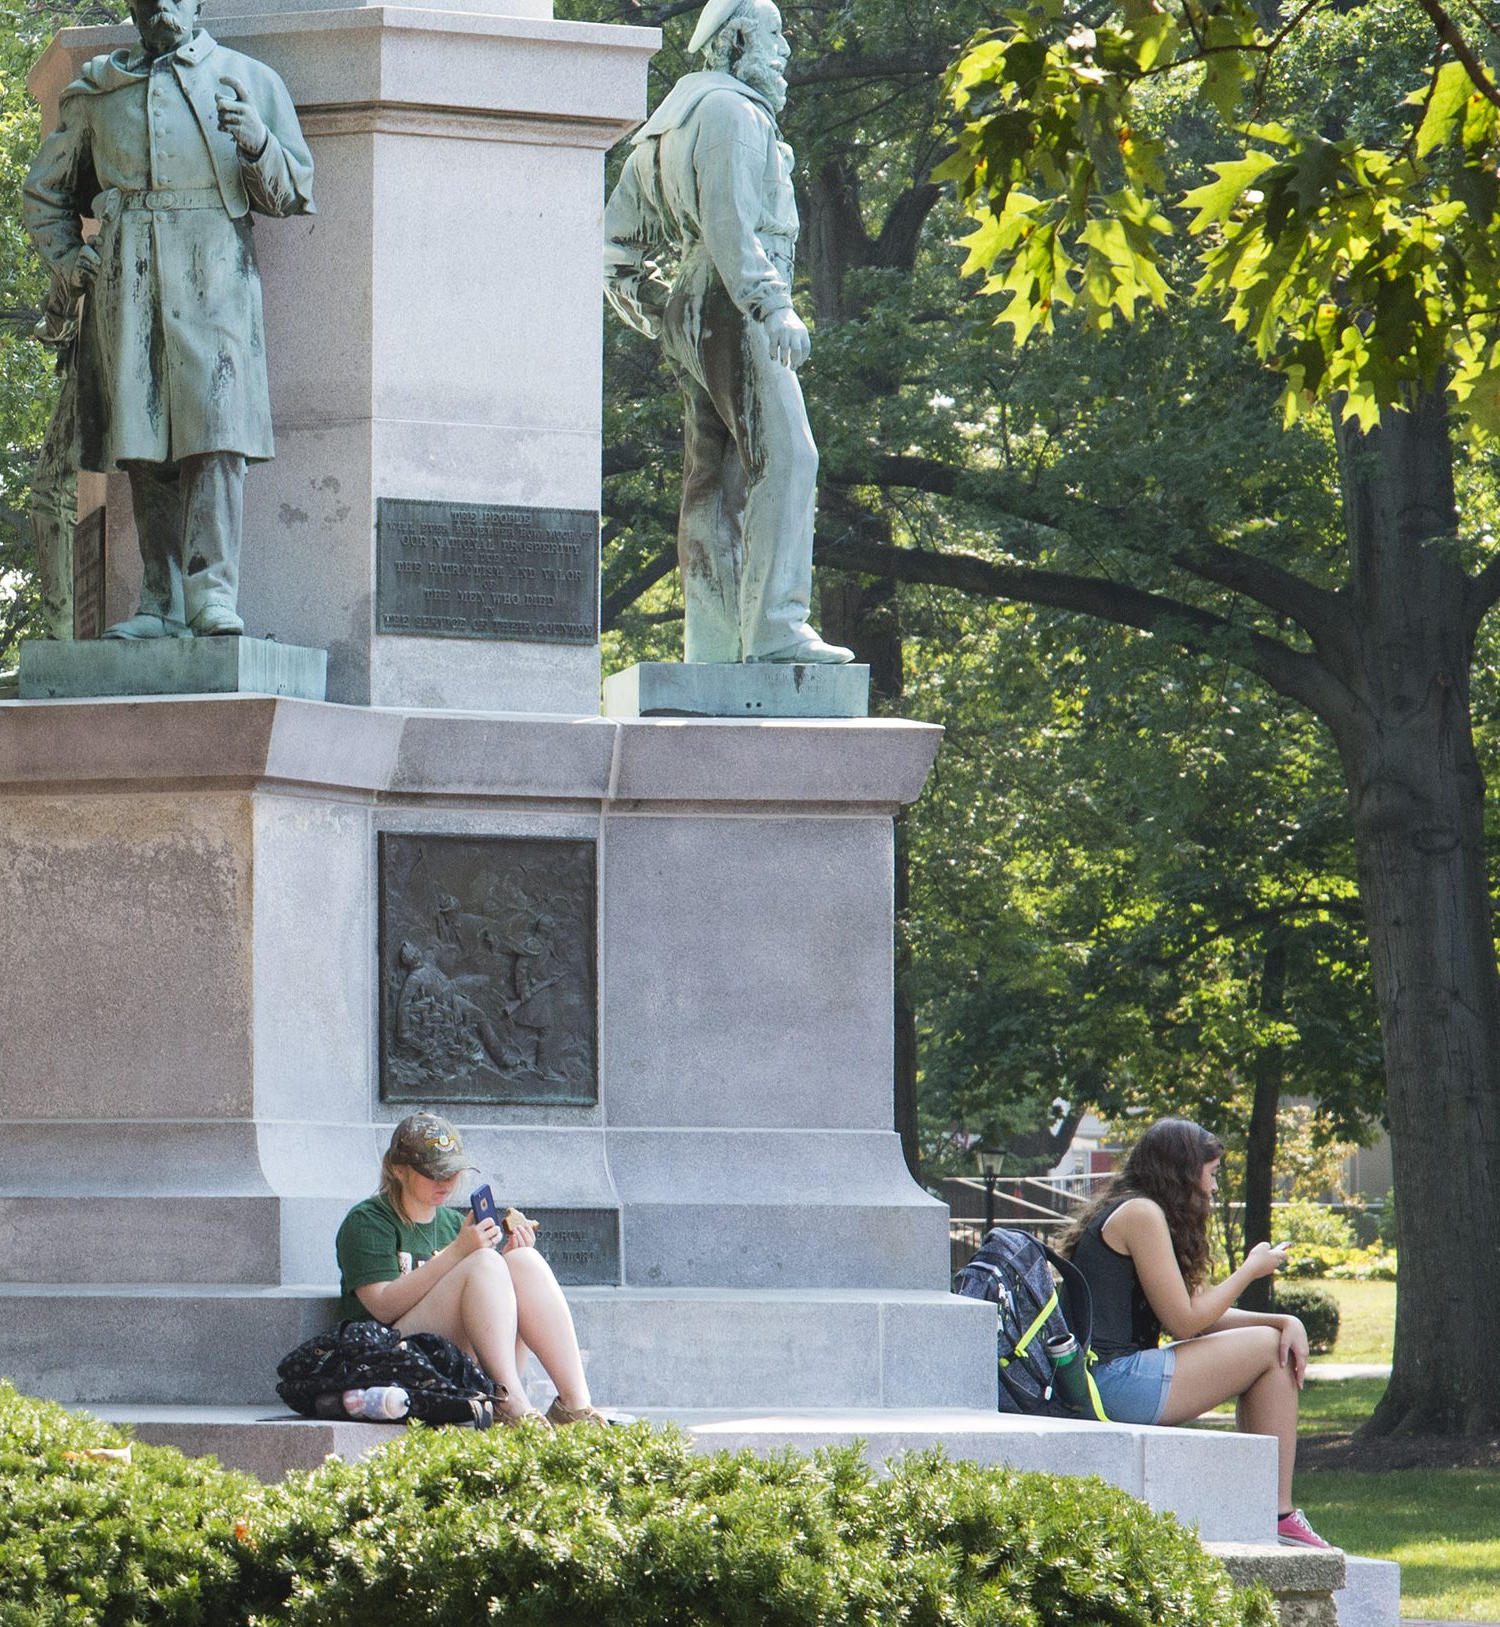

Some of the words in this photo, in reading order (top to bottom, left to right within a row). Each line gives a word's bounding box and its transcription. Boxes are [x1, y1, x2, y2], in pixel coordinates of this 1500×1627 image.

[451, 510, 477, 523] THE
[483, 512, 531, 525] PEOPLE
[401, 534, 429, 547] OUR
[433, 536, 495, 551] NATIONAL
[502, 540, 581, 555] PROSPERITY
[480, 552, 501, 562] DUE
[506, 554, 518, 564] TO
[395, 561, 422, 573] THE
[428, 562, 507, 577] PATRIOTISM
[509, 567, 536, 578] AND
[542, 568, 583, 580] VALOR
[482, 580, 496, 588] OF
[422, 588, 451, 600] THE
[458, 590, 485, 602] MEN
[491, 592, 520, 605] WHO
[525, 594, 556, 606] DIED
[383, 614, 410, 626] THE
[415, 616, 467, 629] SERVICE
[472, 618, 488, 630] OF
[490, 618, 532, 633] THEIR
[536, 622, 594, 635] COUNTRY
